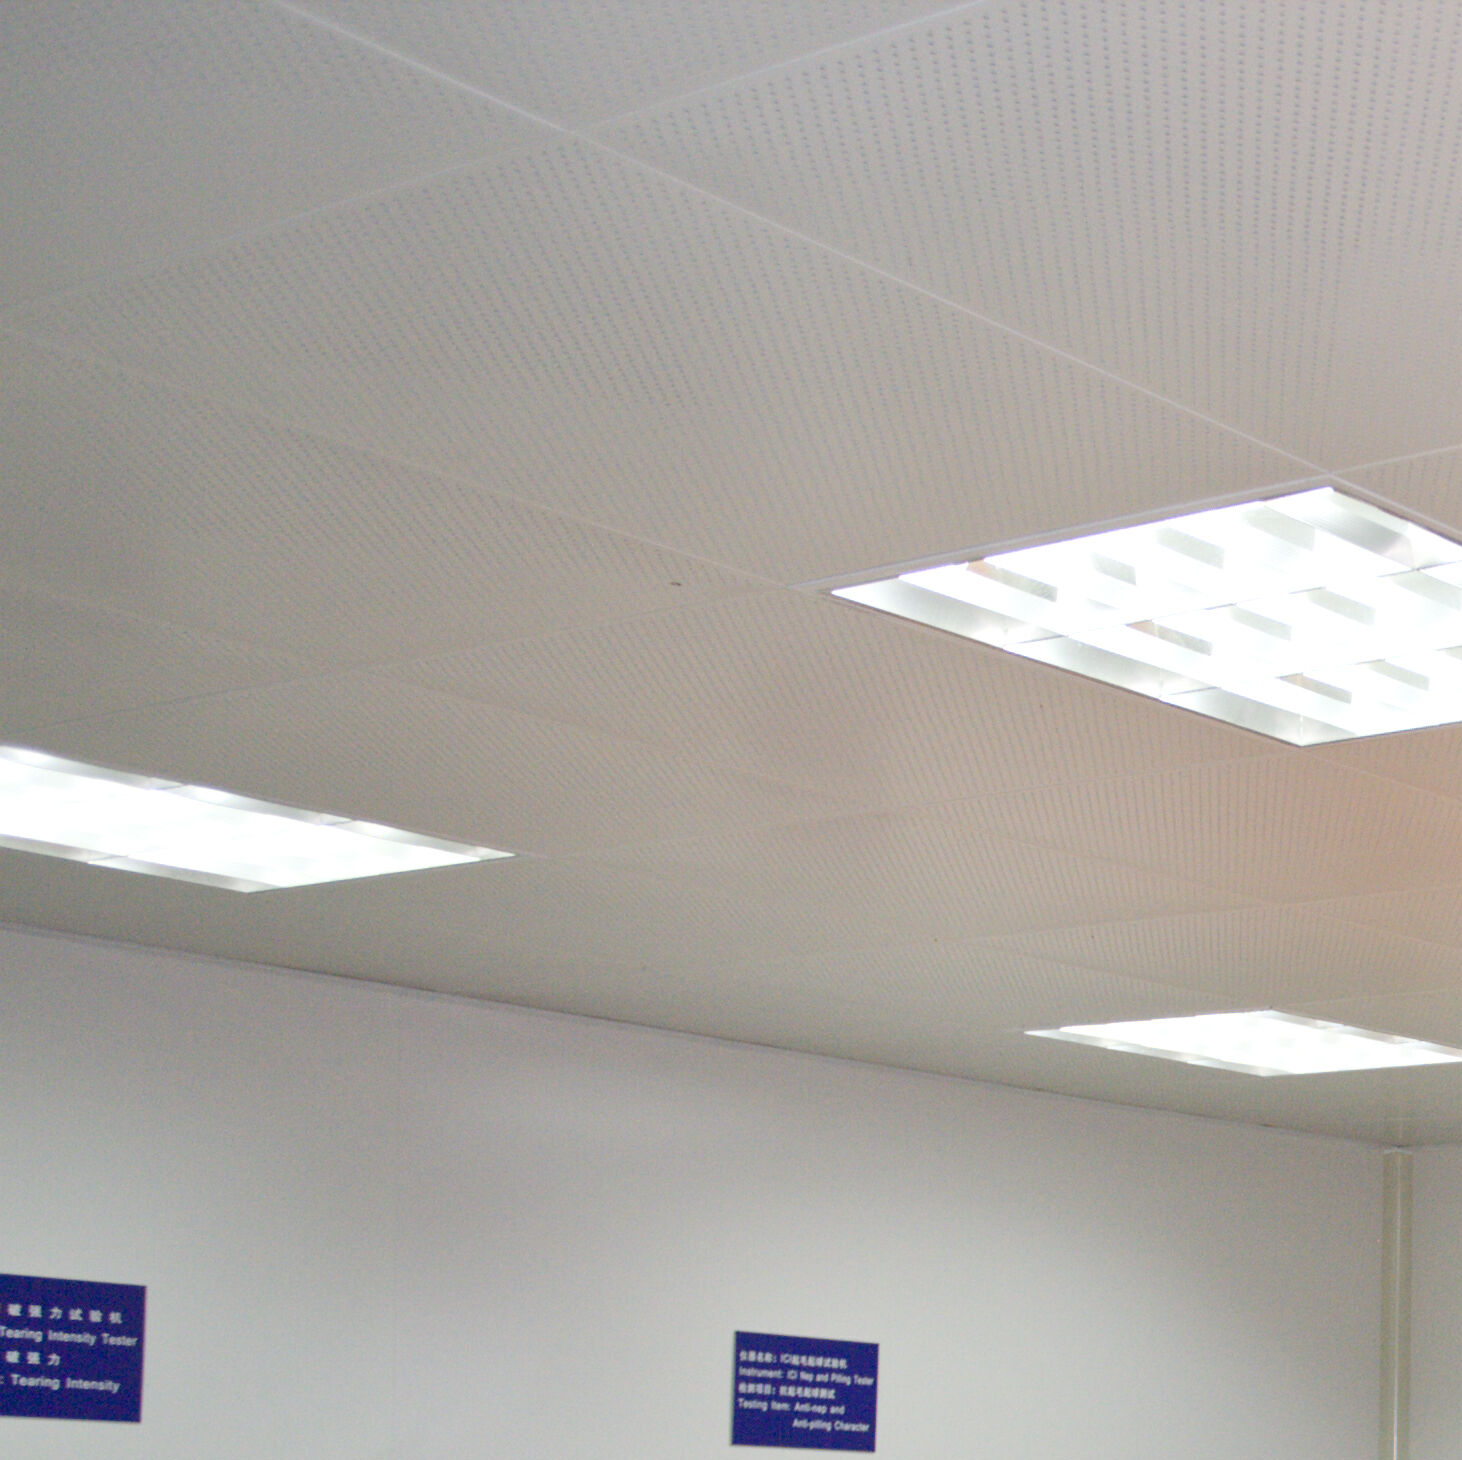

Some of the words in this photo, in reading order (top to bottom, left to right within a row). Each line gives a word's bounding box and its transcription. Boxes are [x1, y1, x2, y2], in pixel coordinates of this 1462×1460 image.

[0, 1326, 43, 1342] Tearing
[47, 1329, 97, 1346] Intensity
[101, 1333, 138, 1346] Tester
[10, 1374, 61, 1390] Tearing
[65, 1377, 121, 1393] Intensity
[739, 1366, 784, 1379] Instrument:
[815, 1372, 829, 1383] and
[830, 1372, 851, 1386] Pilling
[853, 1374, 875, 1386] Tester
[737, 1398, 768, 1412] Testing
[829, 1405, 846, 1415] and
[834, 1420, 870, 1432] Character
